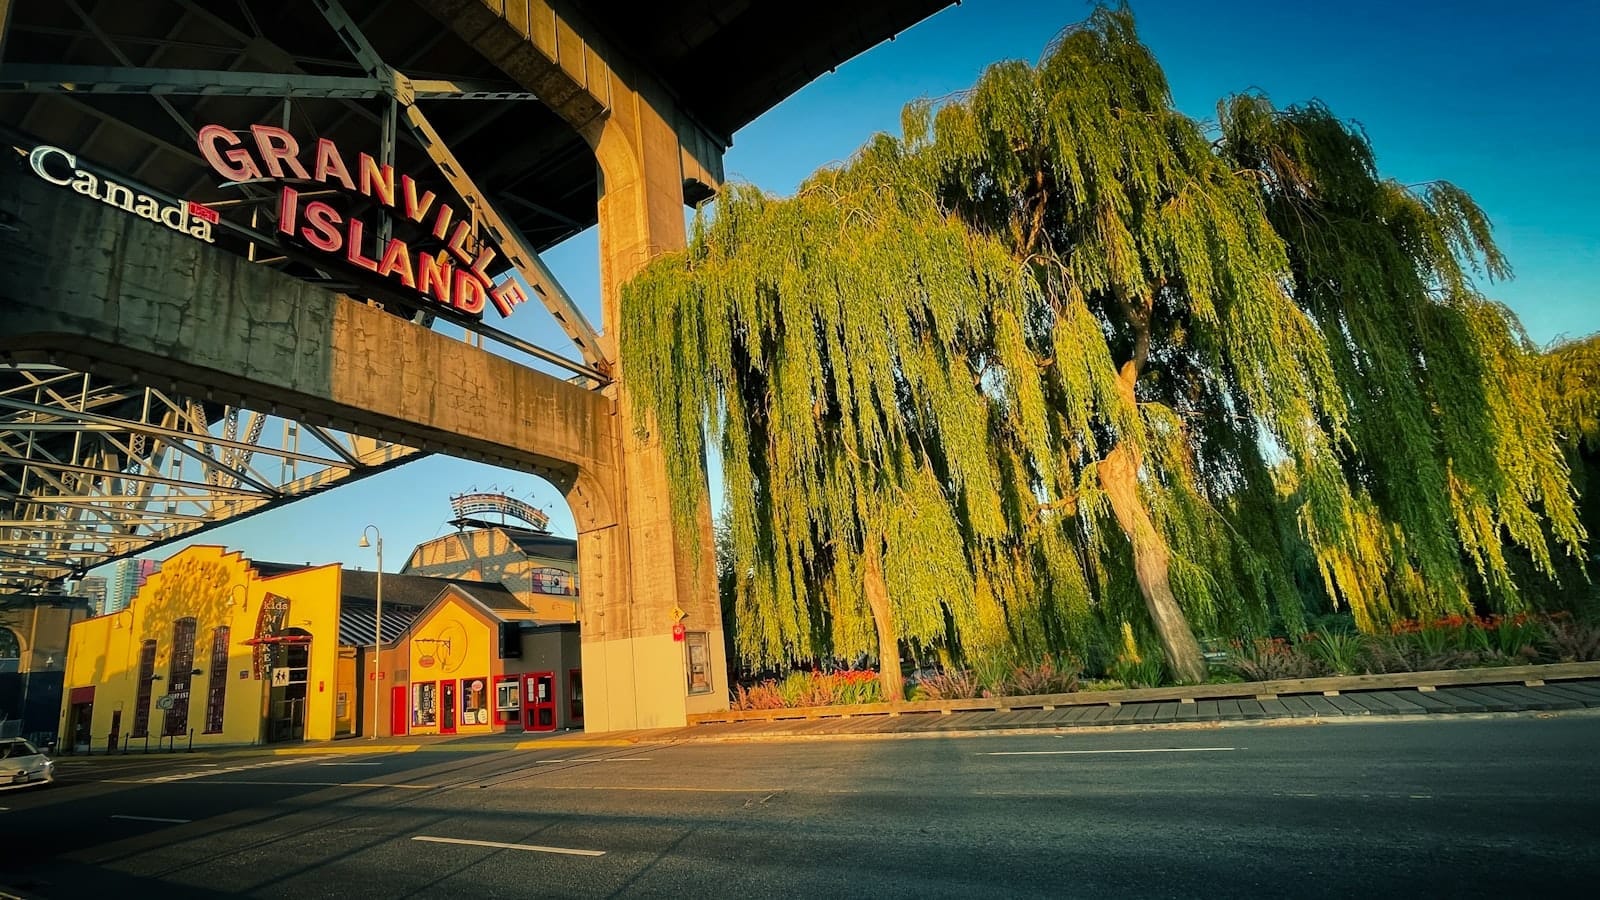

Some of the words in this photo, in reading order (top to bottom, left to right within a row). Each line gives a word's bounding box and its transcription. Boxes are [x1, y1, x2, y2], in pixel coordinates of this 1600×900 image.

[30, 145, 215, 243] Canada
[198, 124, 526, 317] GRANVILLE
[278, 185, 486, 315] ISLAND
